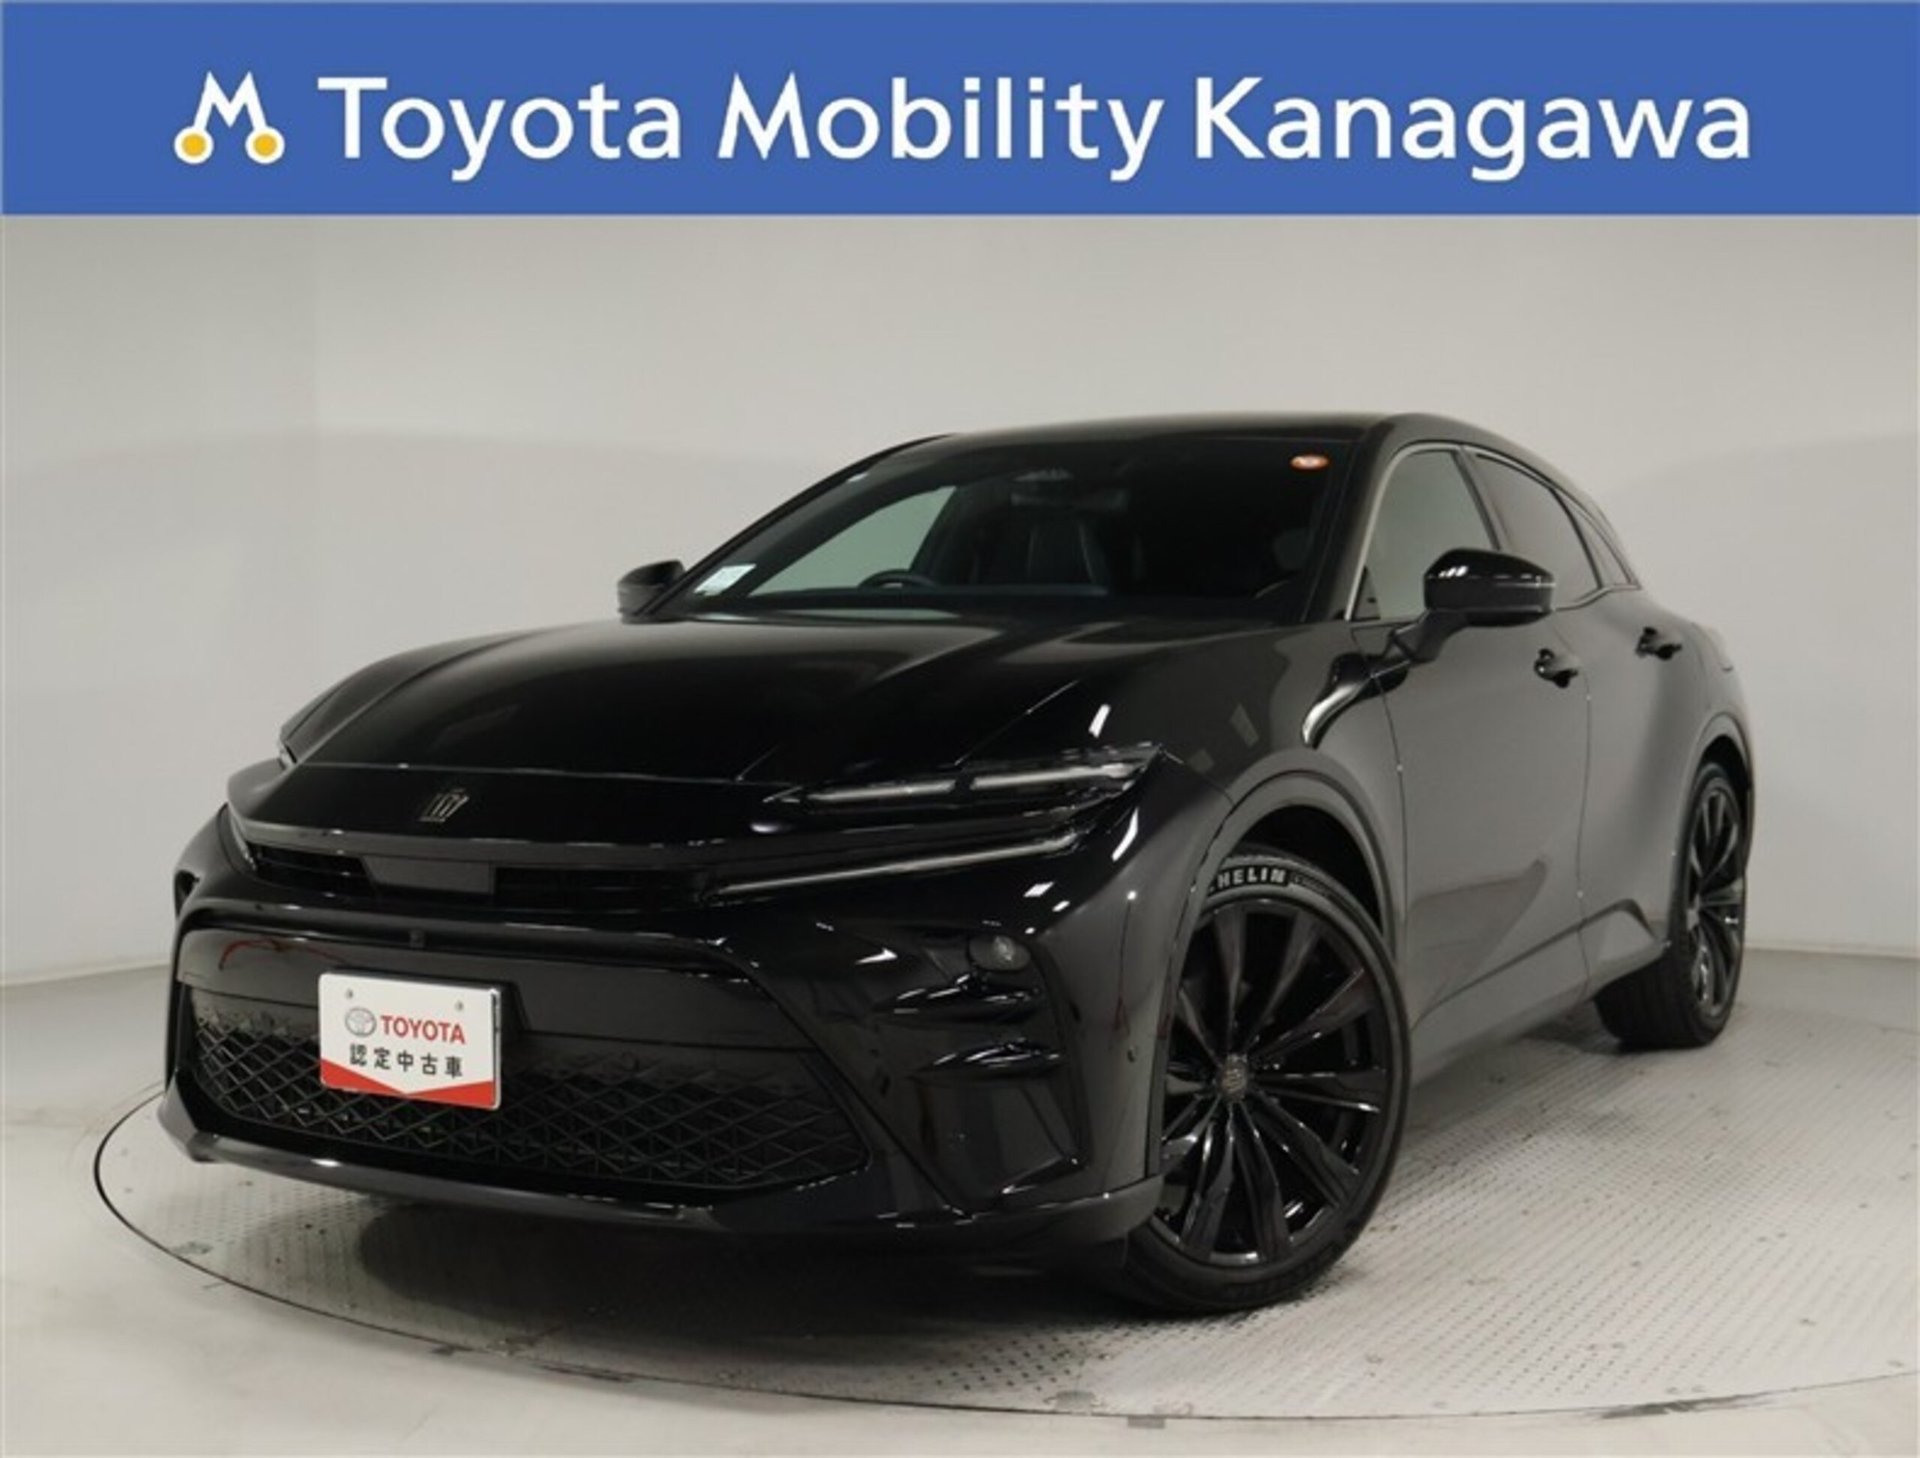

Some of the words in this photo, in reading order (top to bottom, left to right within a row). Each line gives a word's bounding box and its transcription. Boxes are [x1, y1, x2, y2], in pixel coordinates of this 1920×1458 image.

[1209, 866, 1287, 892] HELIN
[381, 1015, 466, 1044] TOYOTA
[349, 1044, 462, 1078] 認定中古車
